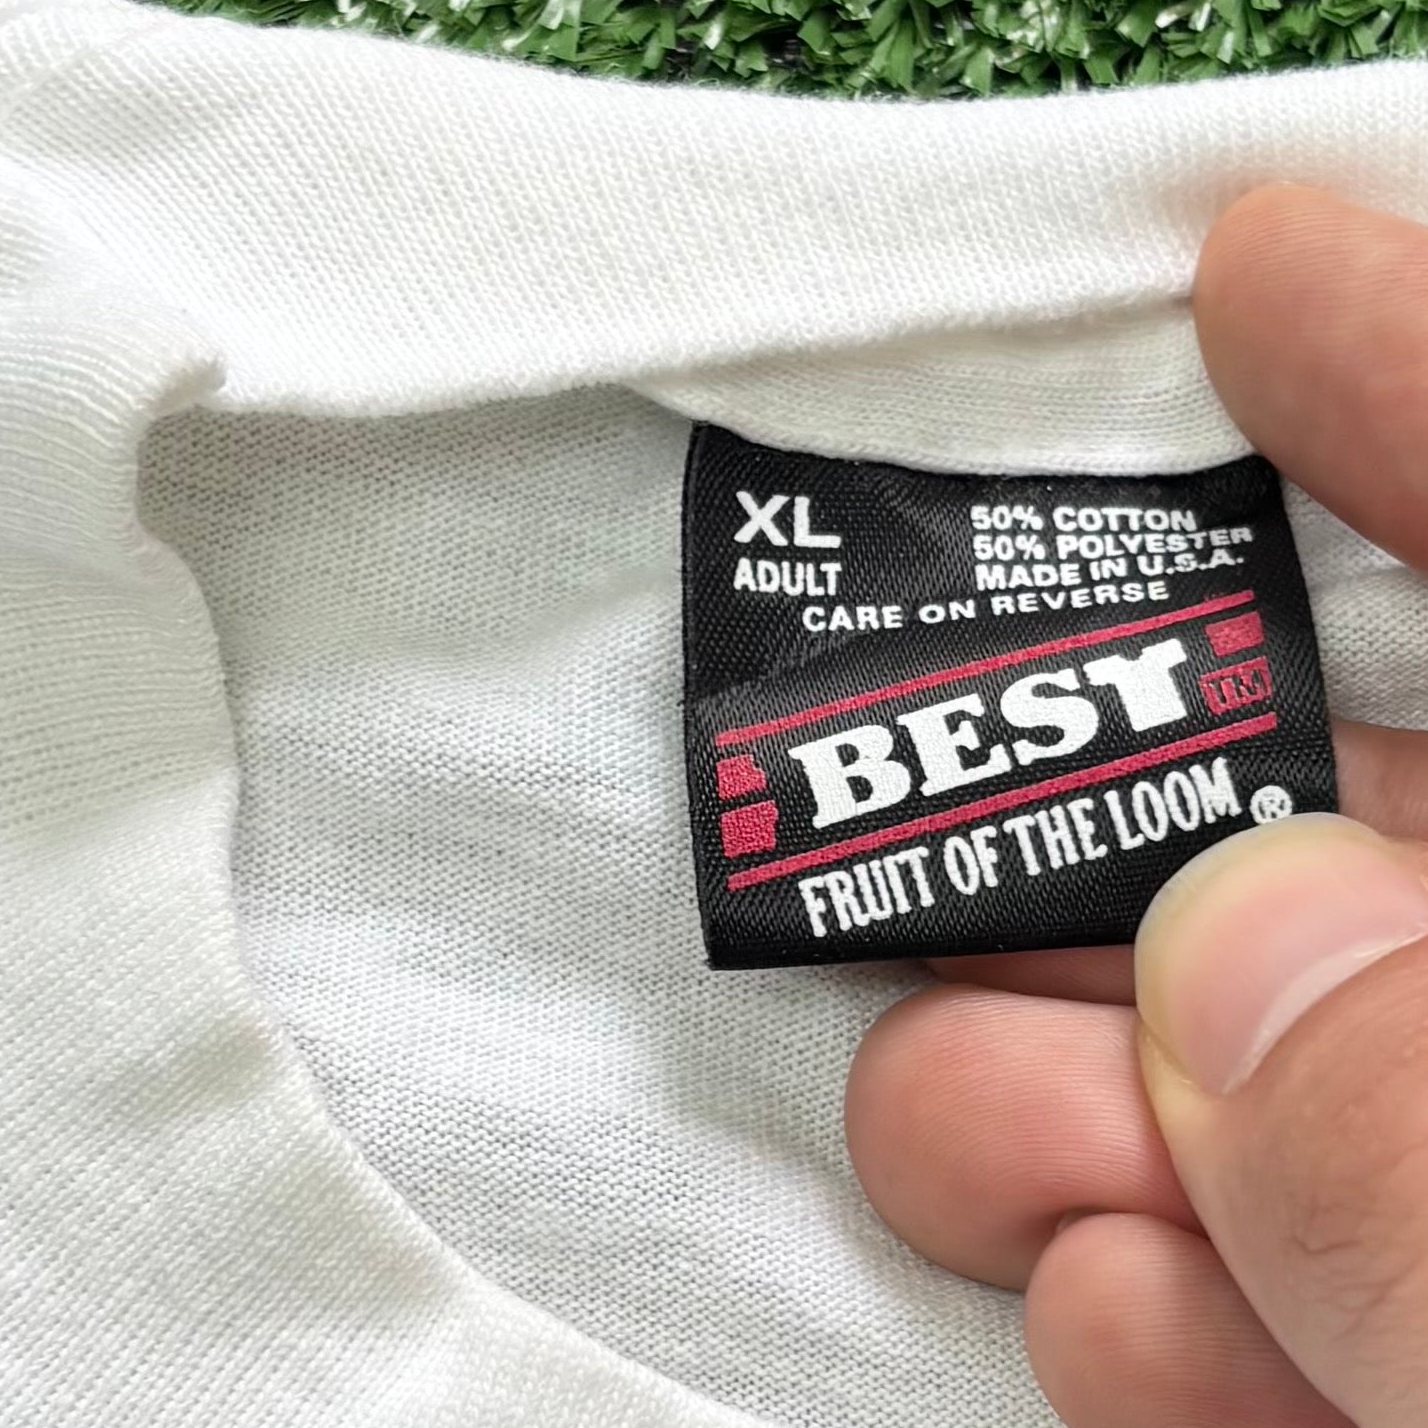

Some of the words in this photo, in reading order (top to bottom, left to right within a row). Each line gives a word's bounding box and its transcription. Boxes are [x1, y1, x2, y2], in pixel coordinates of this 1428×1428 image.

[735, 492, 841, 548] XL
[972, 506, 1042, 531] 50%
[1053, 507, 1196, 532] COTTON
[973, 534, 1045, 560] 50%
[1057, 526, 1253, 559] POLYESTER
[734, 557, 841, 596] ADULT
[975, 562, 1082, 591] MADE
[1091, 559, 1128, 582] IN
[1137, 550, 1244, 576] U.S.A.
[803, 602, 903, 632] CARE
[919, 598, 975, 624] ON
[992, 582, 1168, 615] REVERSE
[788, 638, 1186, 828] BEST
[798, 845, 934, 939] FRUIT
[943, 828, 998, 896] OF
[1004, 796, 1108, 877] THE
[1105, 758, 1242, 849] LOOM
